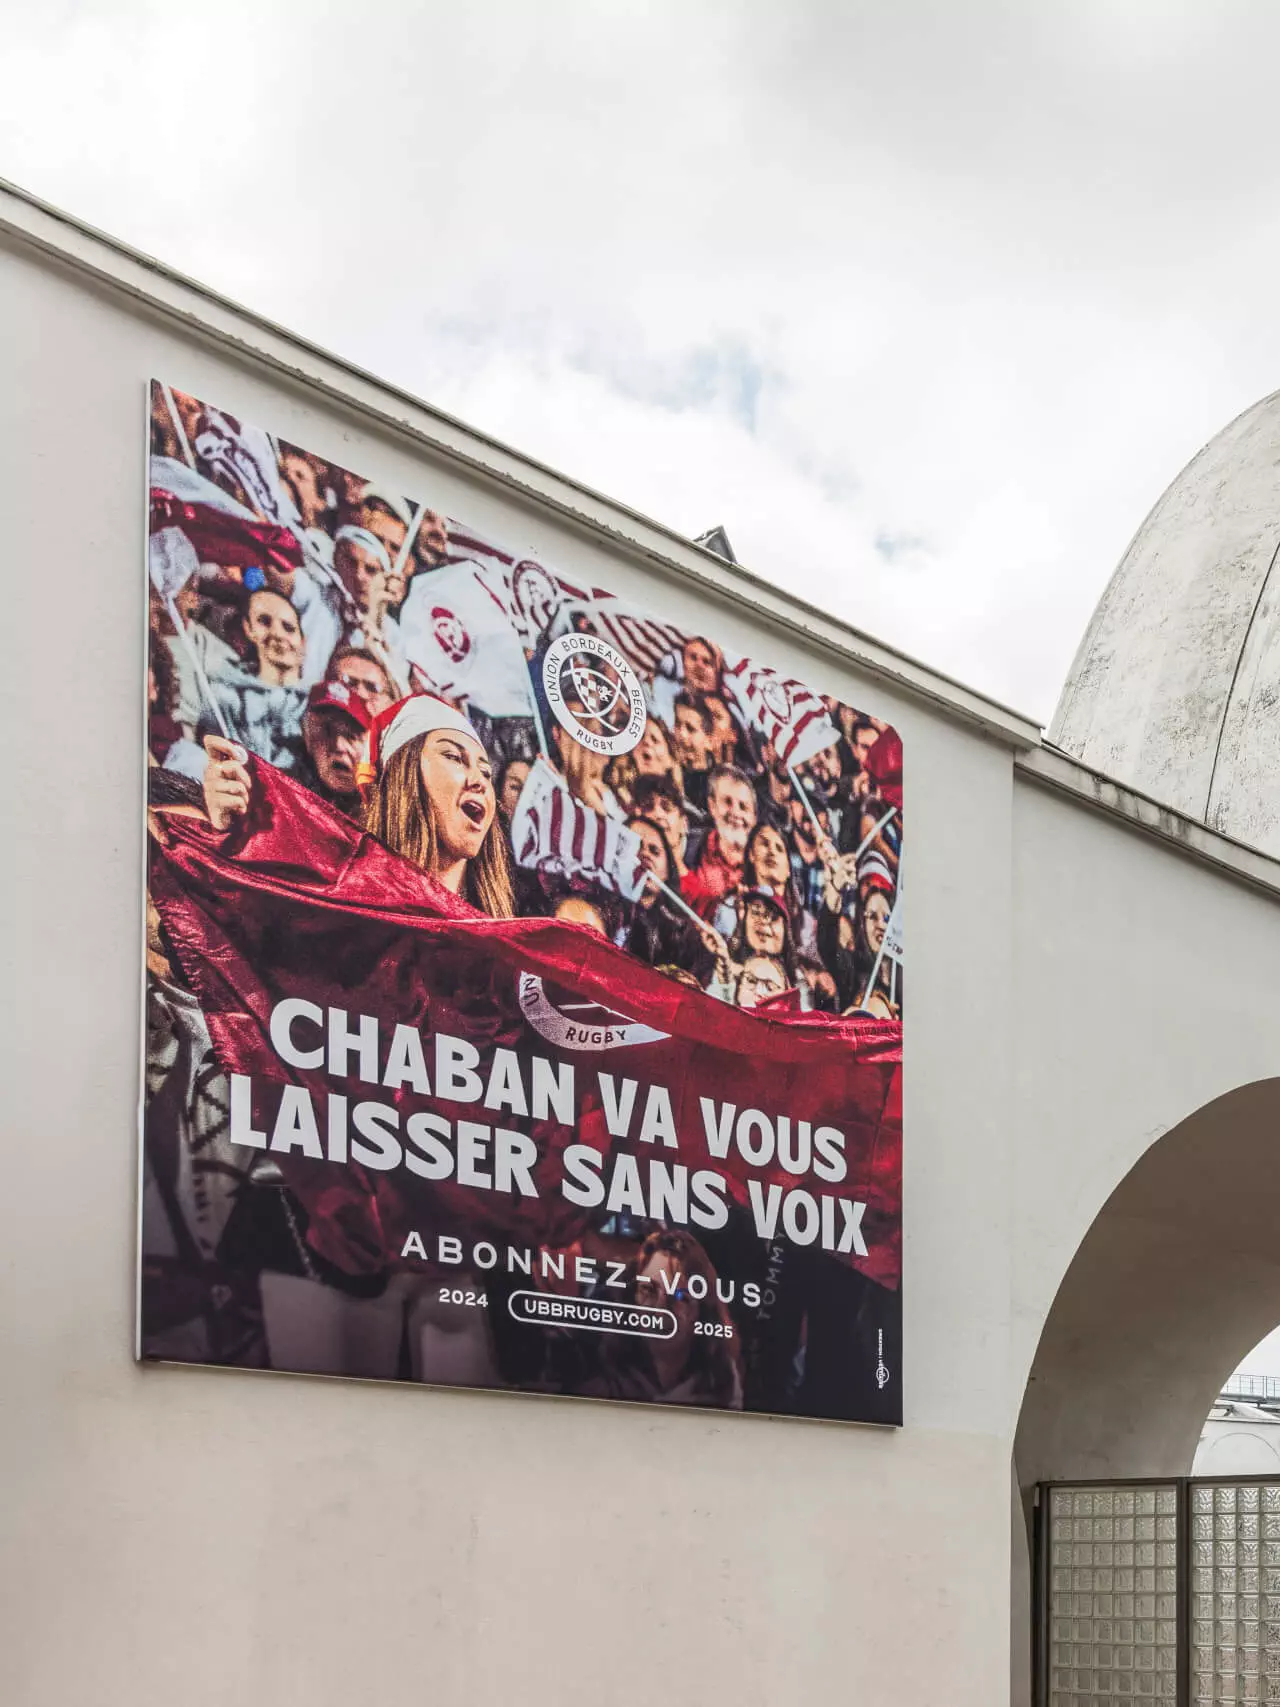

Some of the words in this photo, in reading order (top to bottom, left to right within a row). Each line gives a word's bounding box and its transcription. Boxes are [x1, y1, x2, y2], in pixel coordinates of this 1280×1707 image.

[547, 653, 560, 702] UNION
[561, 638, 631, 677] BORDEAUX
[629, 689, 643, 738] BEGLES
[576, 729, 613, 751] RUGBY
[565, 1026, 627, 1043] RUGBY
[270, 999, 575, 1127] CHABAN
[598, 1072, 679, 1149] VA
[700, 1097, 847, 1183] VOUS
[230, 1073, 539, 1198] LAISSER
[563, 1144, 729, 1230] SANS
[748, 1180, 869, 1257] VOIX
[401, 1231, 761, 1307] ABONNEZ-VOUS
[439, 1288, 489, 1308] 2024
[524, 1299, 664, 1330] UBBRUGBY.COM
[693, 1321, 733, 1338] 2025
